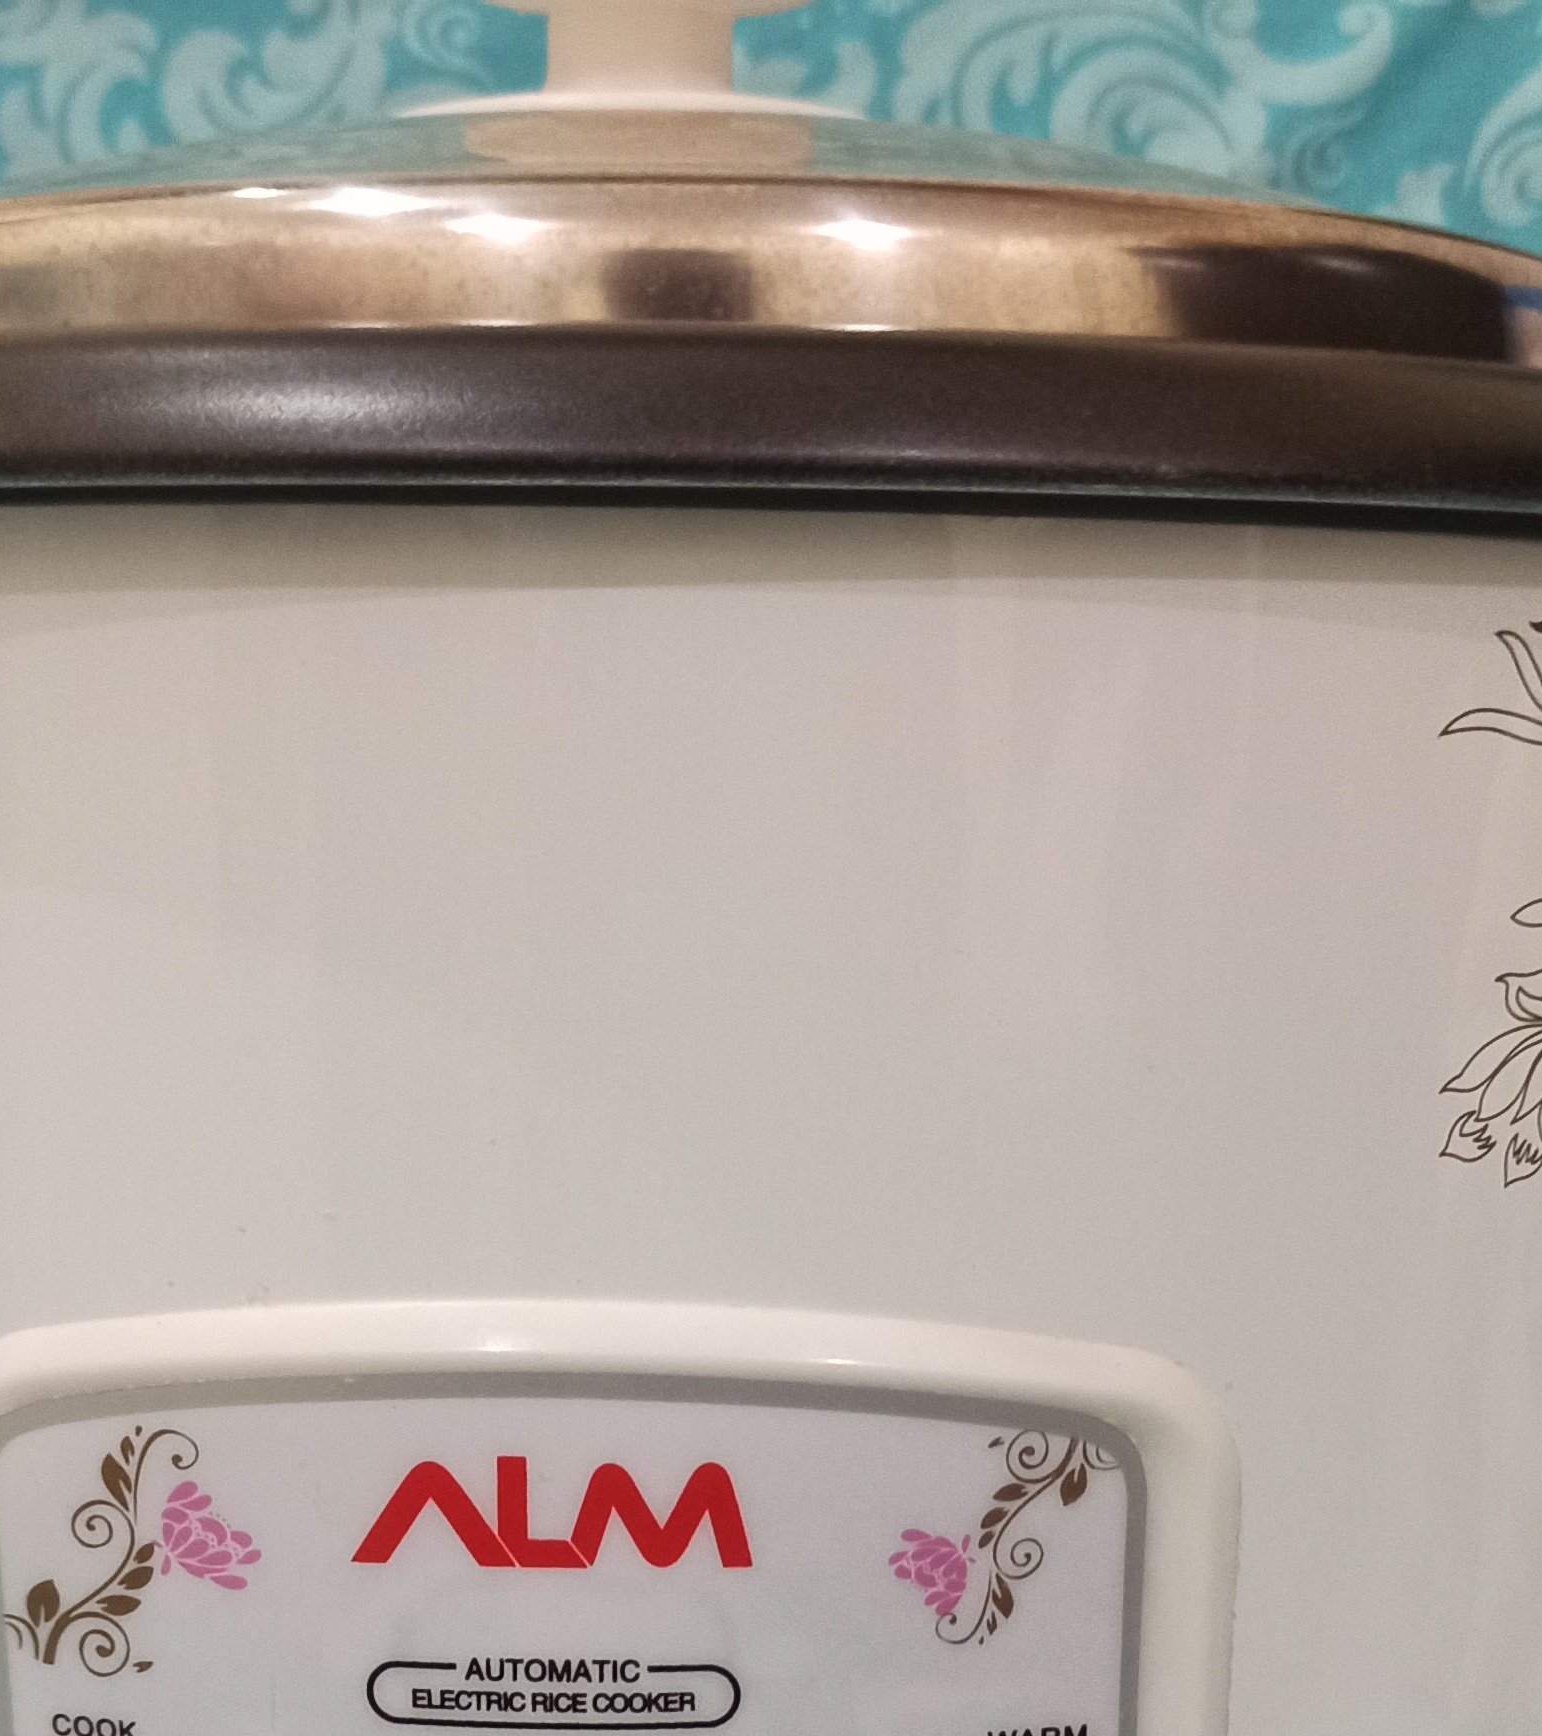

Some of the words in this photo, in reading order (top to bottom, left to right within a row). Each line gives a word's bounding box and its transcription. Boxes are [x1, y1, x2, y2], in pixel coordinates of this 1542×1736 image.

[351, 1455, 753, 1569] ALM
[464, 1657, 641, 1684] AUTOMATIC
[411, 1687, 527, 1712] ELECTRIC
[530, 1690, 588, 1713] RICE
[591, 1691, 696, 1714] COOKER
